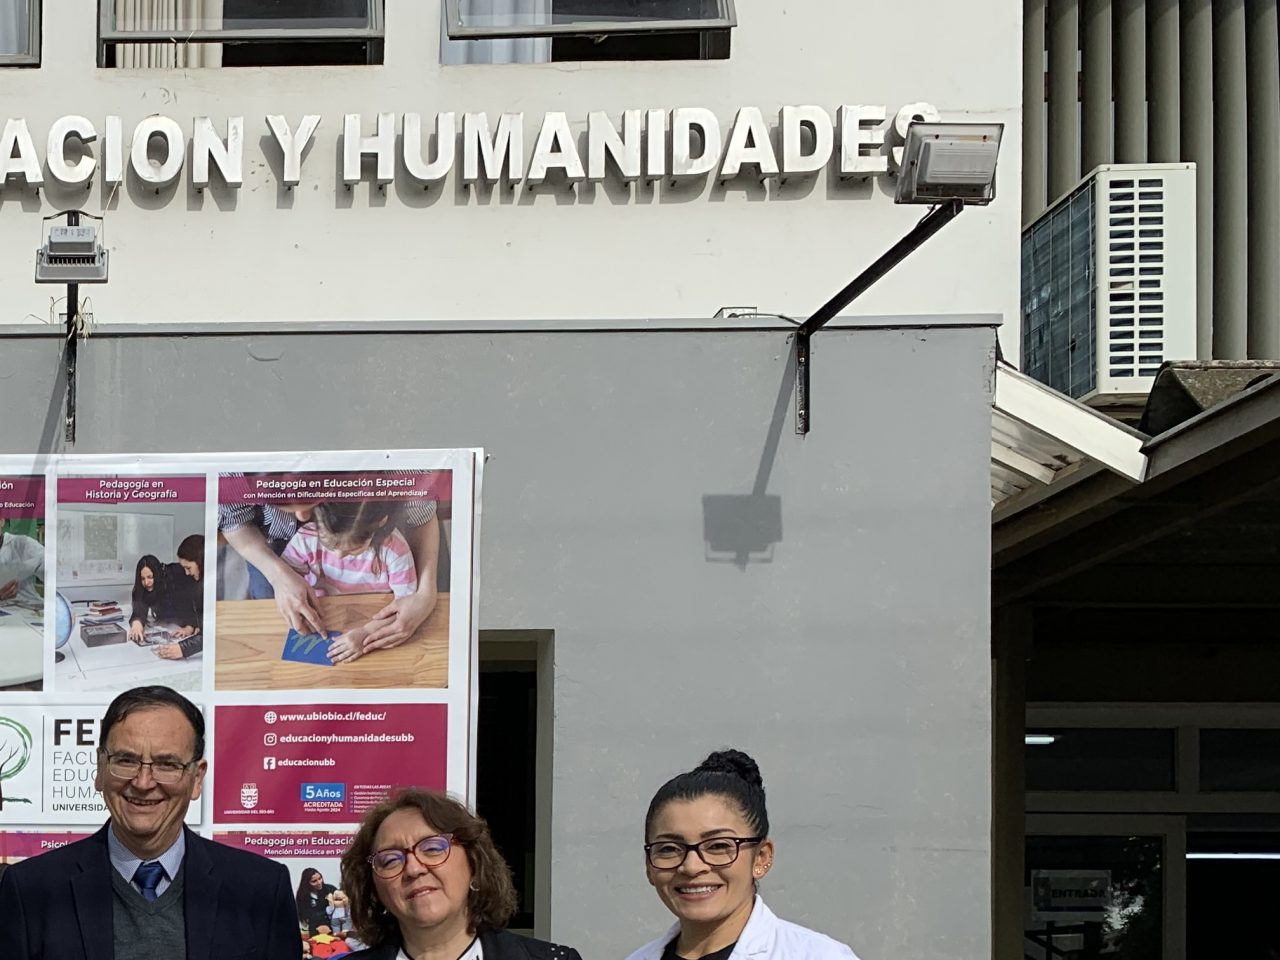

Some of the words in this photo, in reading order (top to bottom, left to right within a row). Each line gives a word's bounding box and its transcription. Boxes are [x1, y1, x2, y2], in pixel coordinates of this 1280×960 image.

[266, 113, 322, 187] Y
[99, 480, 149, 490] Pedagogía
[256, 480, 306, 490] Pedagogía
[324, 478, 373, 487] Educación
[376, 478, 415, 488] Especial
[86, 490, 120, 498] Historia
[124, 492, 129, 500] y
[132, 490, 177, 500] Geografía
[280, 712, 386, 721] www.ubiobio.cl/feduc/
[54, 719, 104, 746] FE
[280, 733, 414, 744] educacionyhumanidadesubb
[278, 758, 335, 766] educacionubb
[306, 786, 315, 799] 5
[316, 788, 341, 798] Años
[244, 837, 294, 847] Pedagogía
[1052, 889, 1105, 898] ENTRADA
